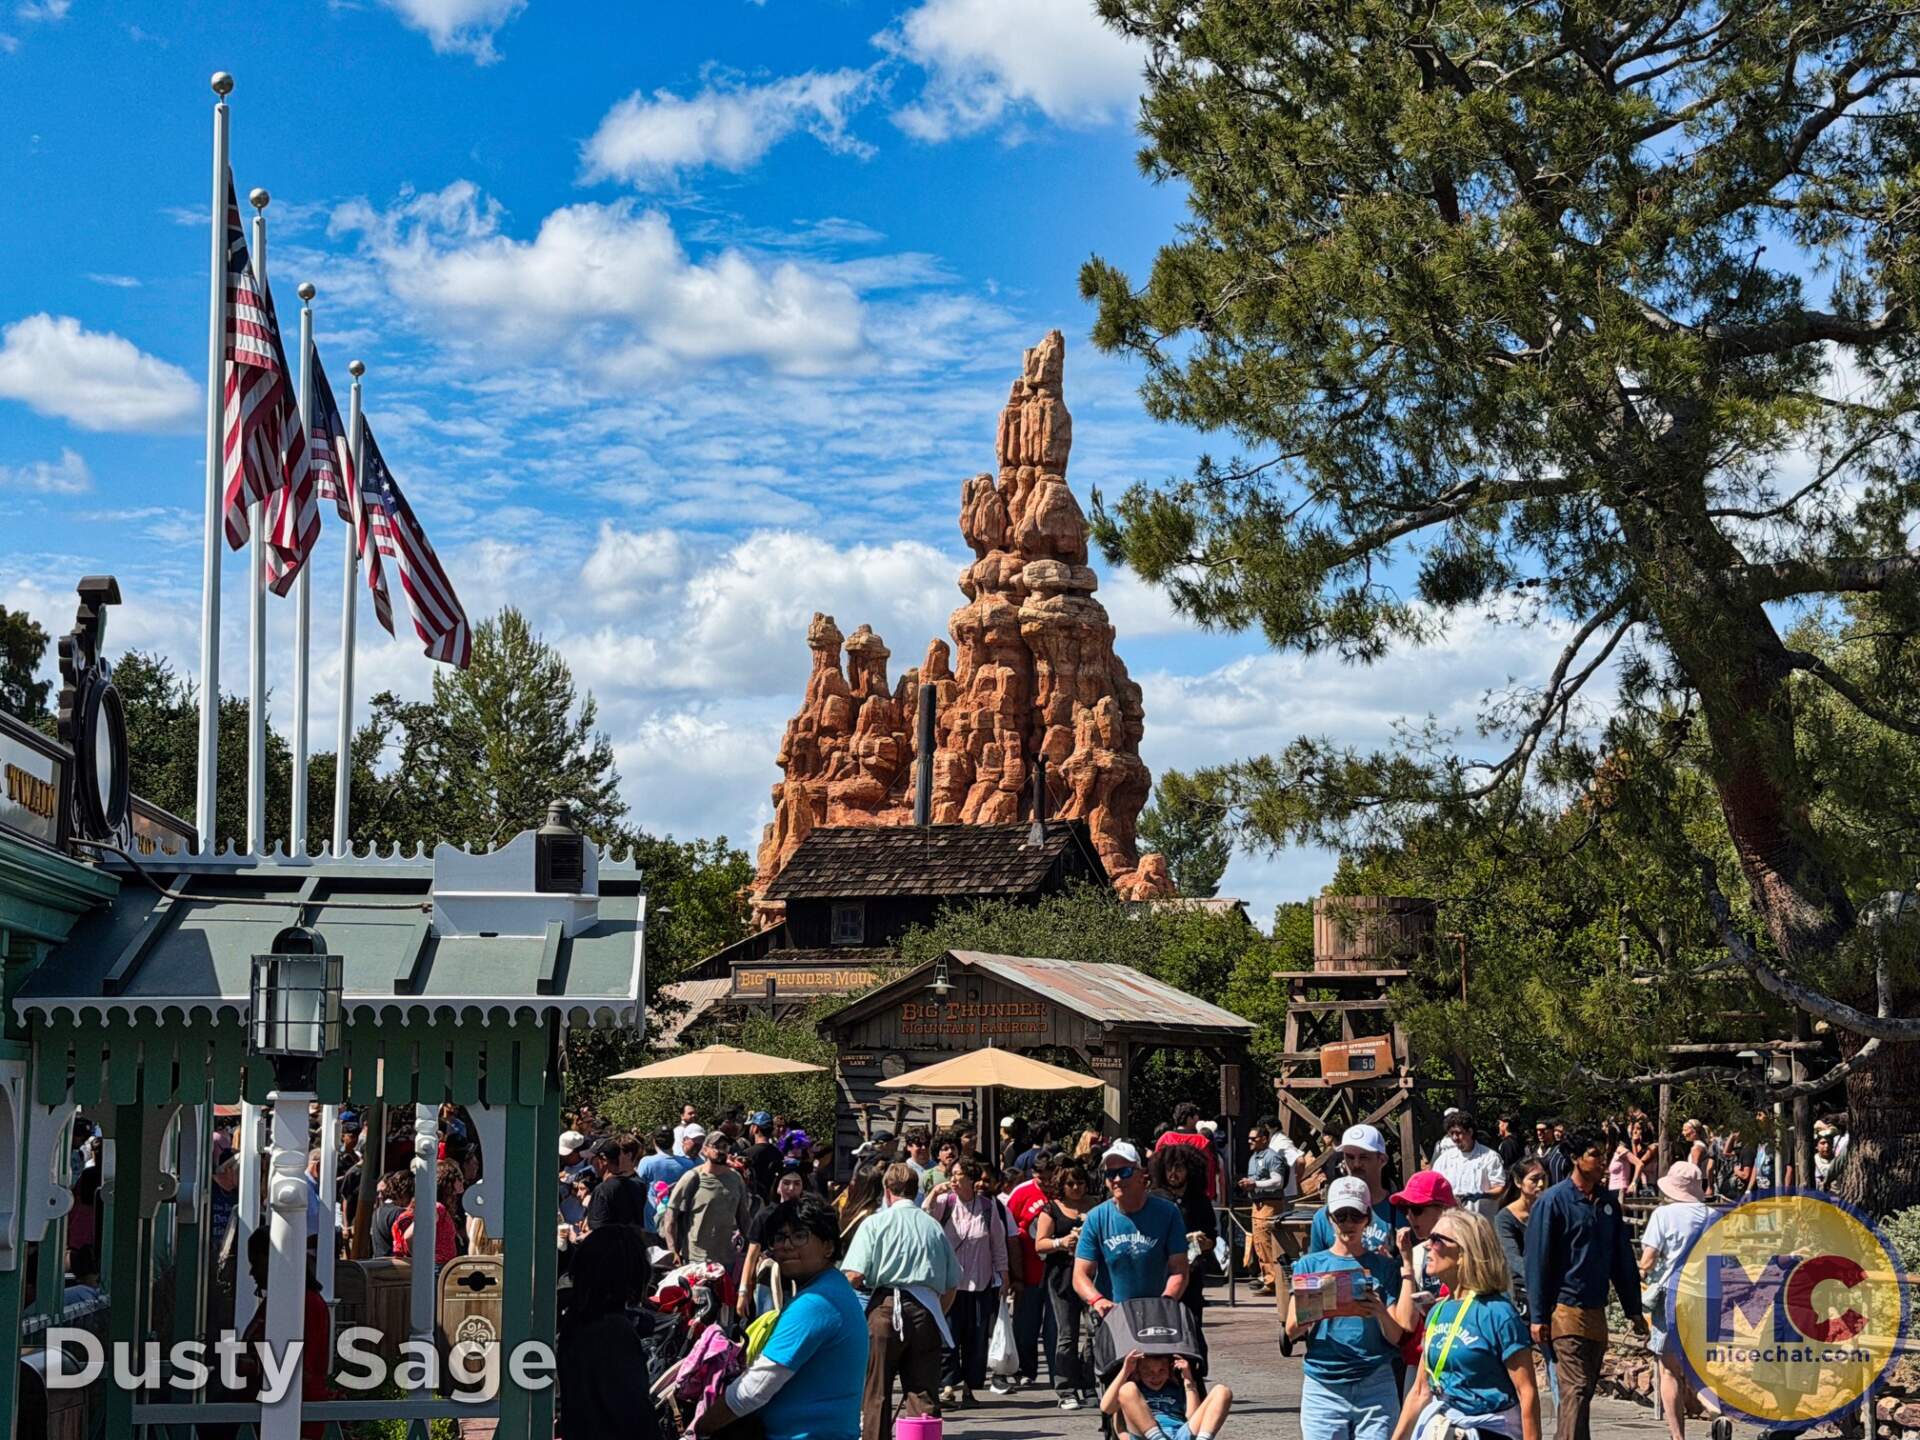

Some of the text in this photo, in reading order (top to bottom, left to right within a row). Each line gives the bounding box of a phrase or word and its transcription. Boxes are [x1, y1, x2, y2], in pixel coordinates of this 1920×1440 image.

[740, 972, 763, 986] BIG
[902, 1002, 1048, 1022] BIG THUNDER
[901, 1022, 1048, 1034] MOUNTAIN RAILROAD
[1362, 1058, 1375, 1069] 50
